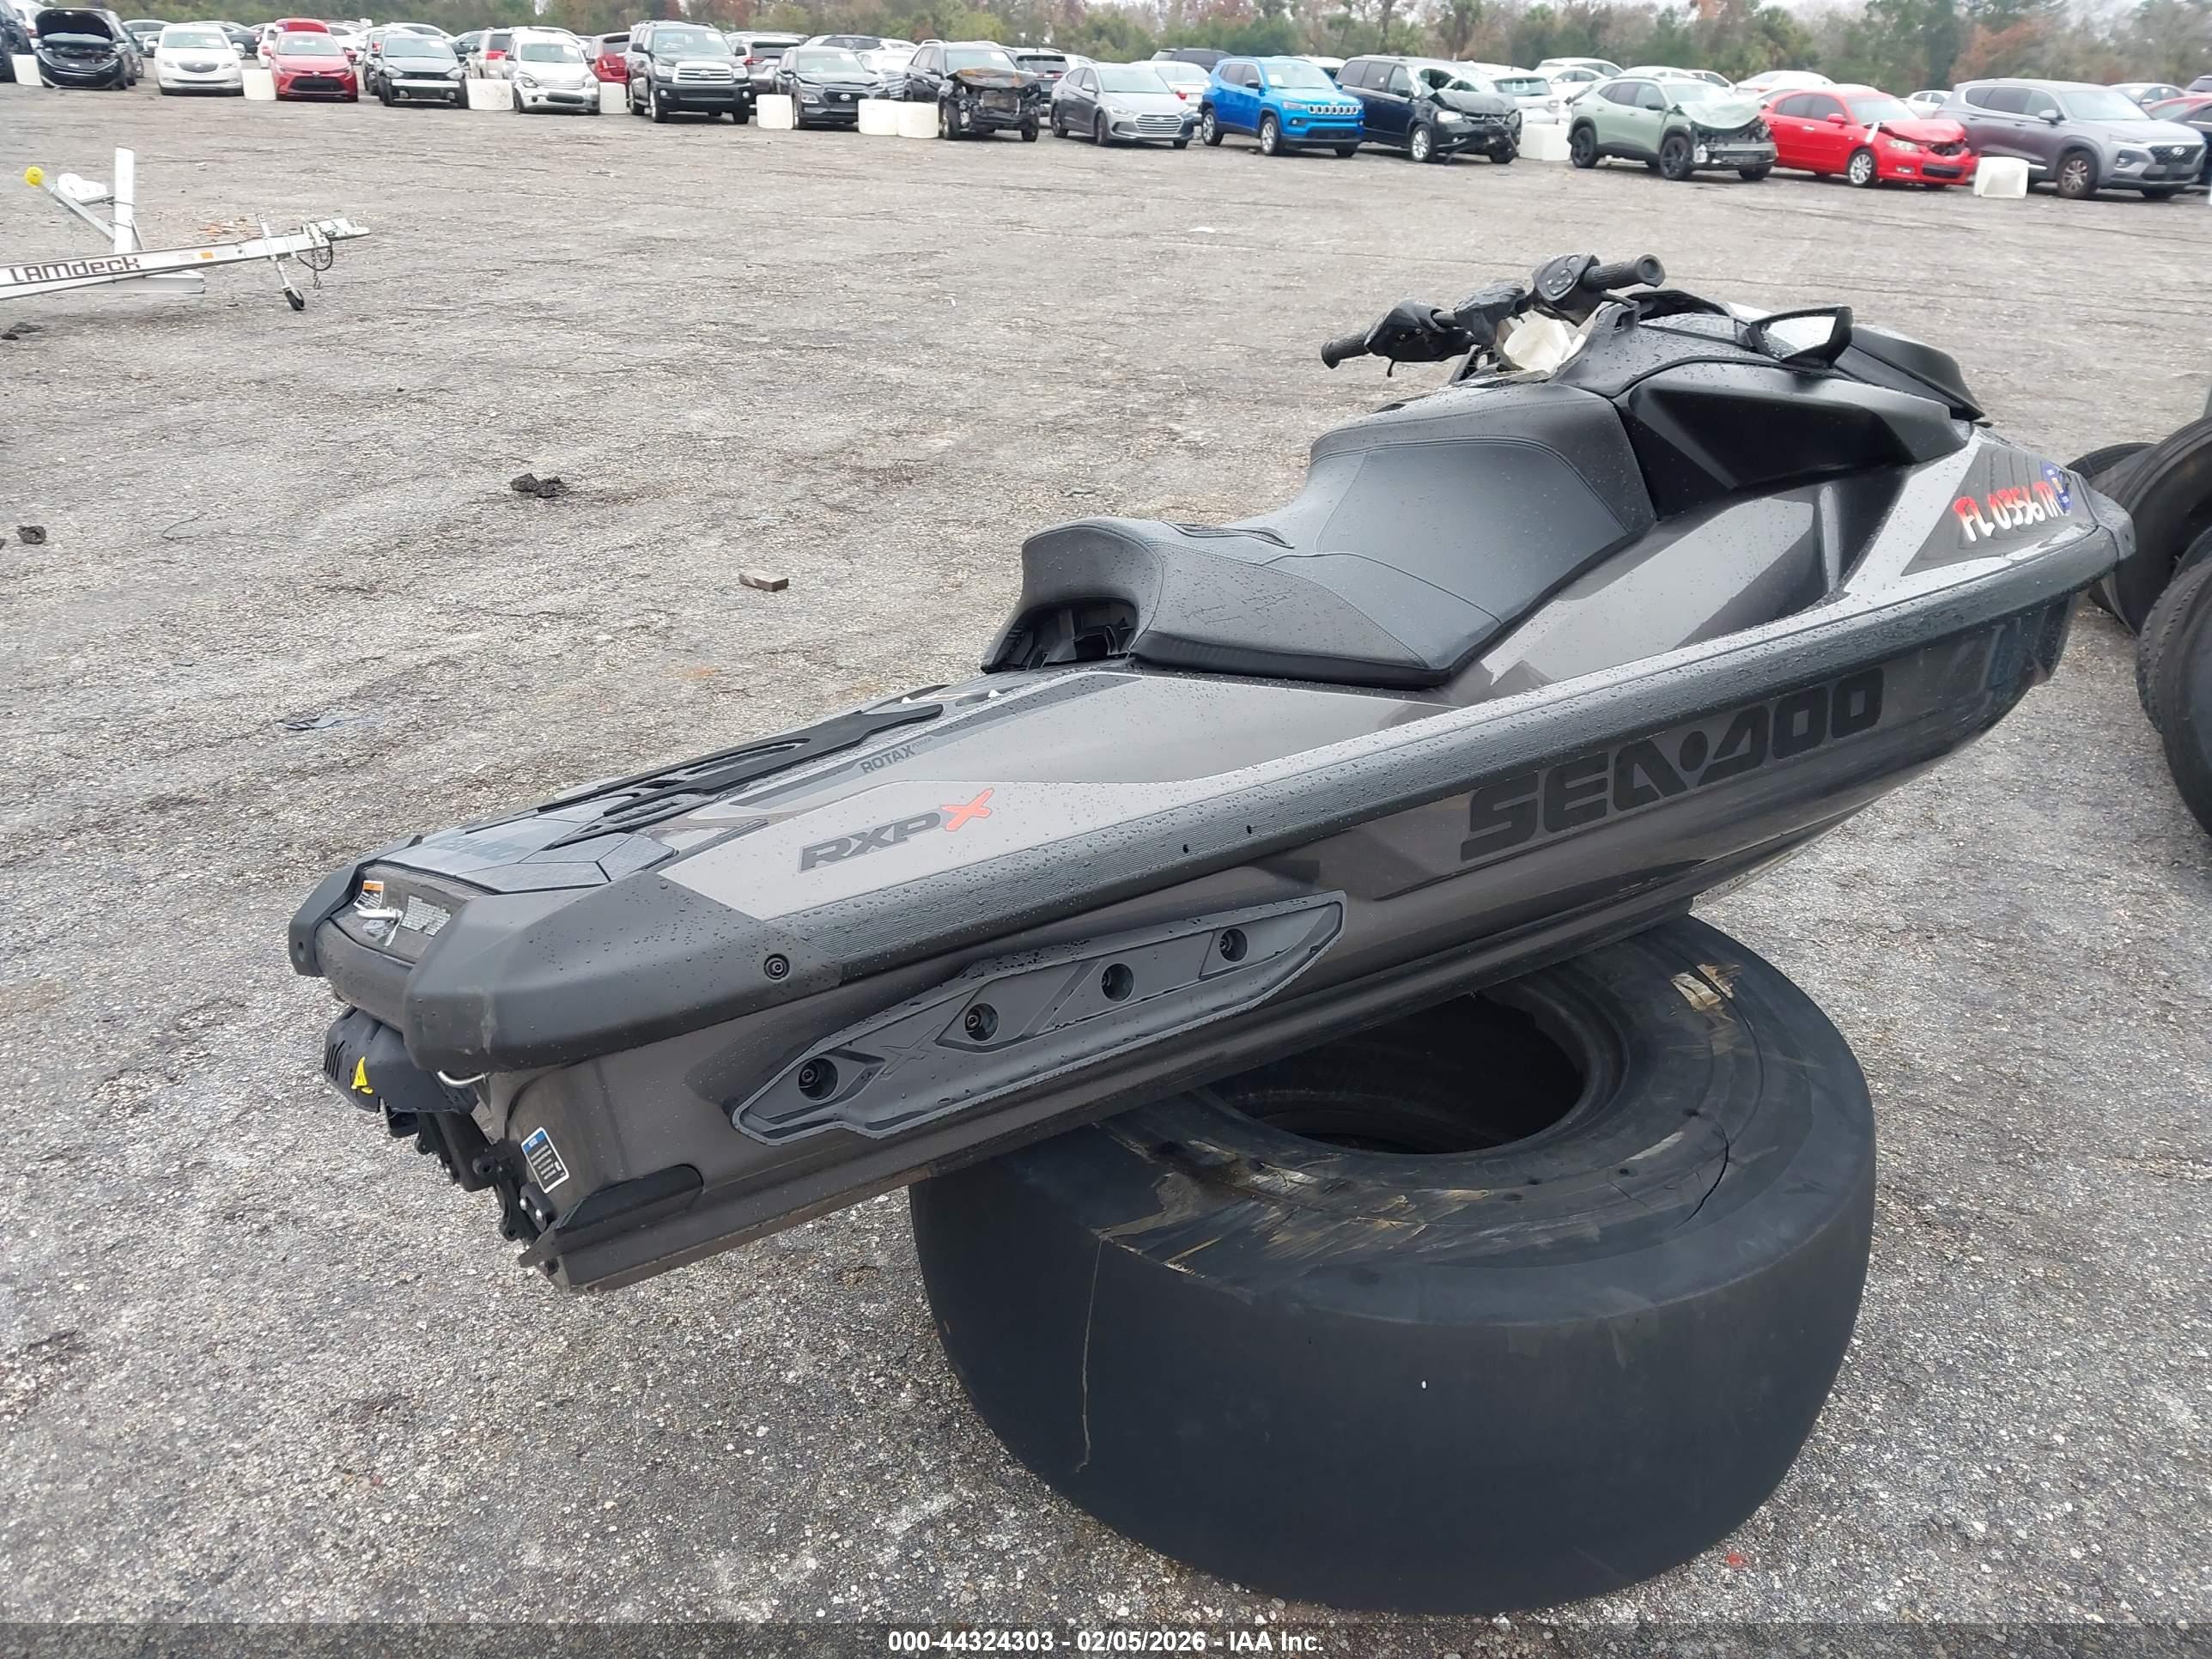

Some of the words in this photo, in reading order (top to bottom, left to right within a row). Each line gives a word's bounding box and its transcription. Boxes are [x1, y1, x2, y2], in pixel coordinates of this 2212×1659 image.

[1954, 496, 1995, 542] FL
[1989, 487, 2045, 530] 0356
[860, 744, 916, 774] ROTAX
